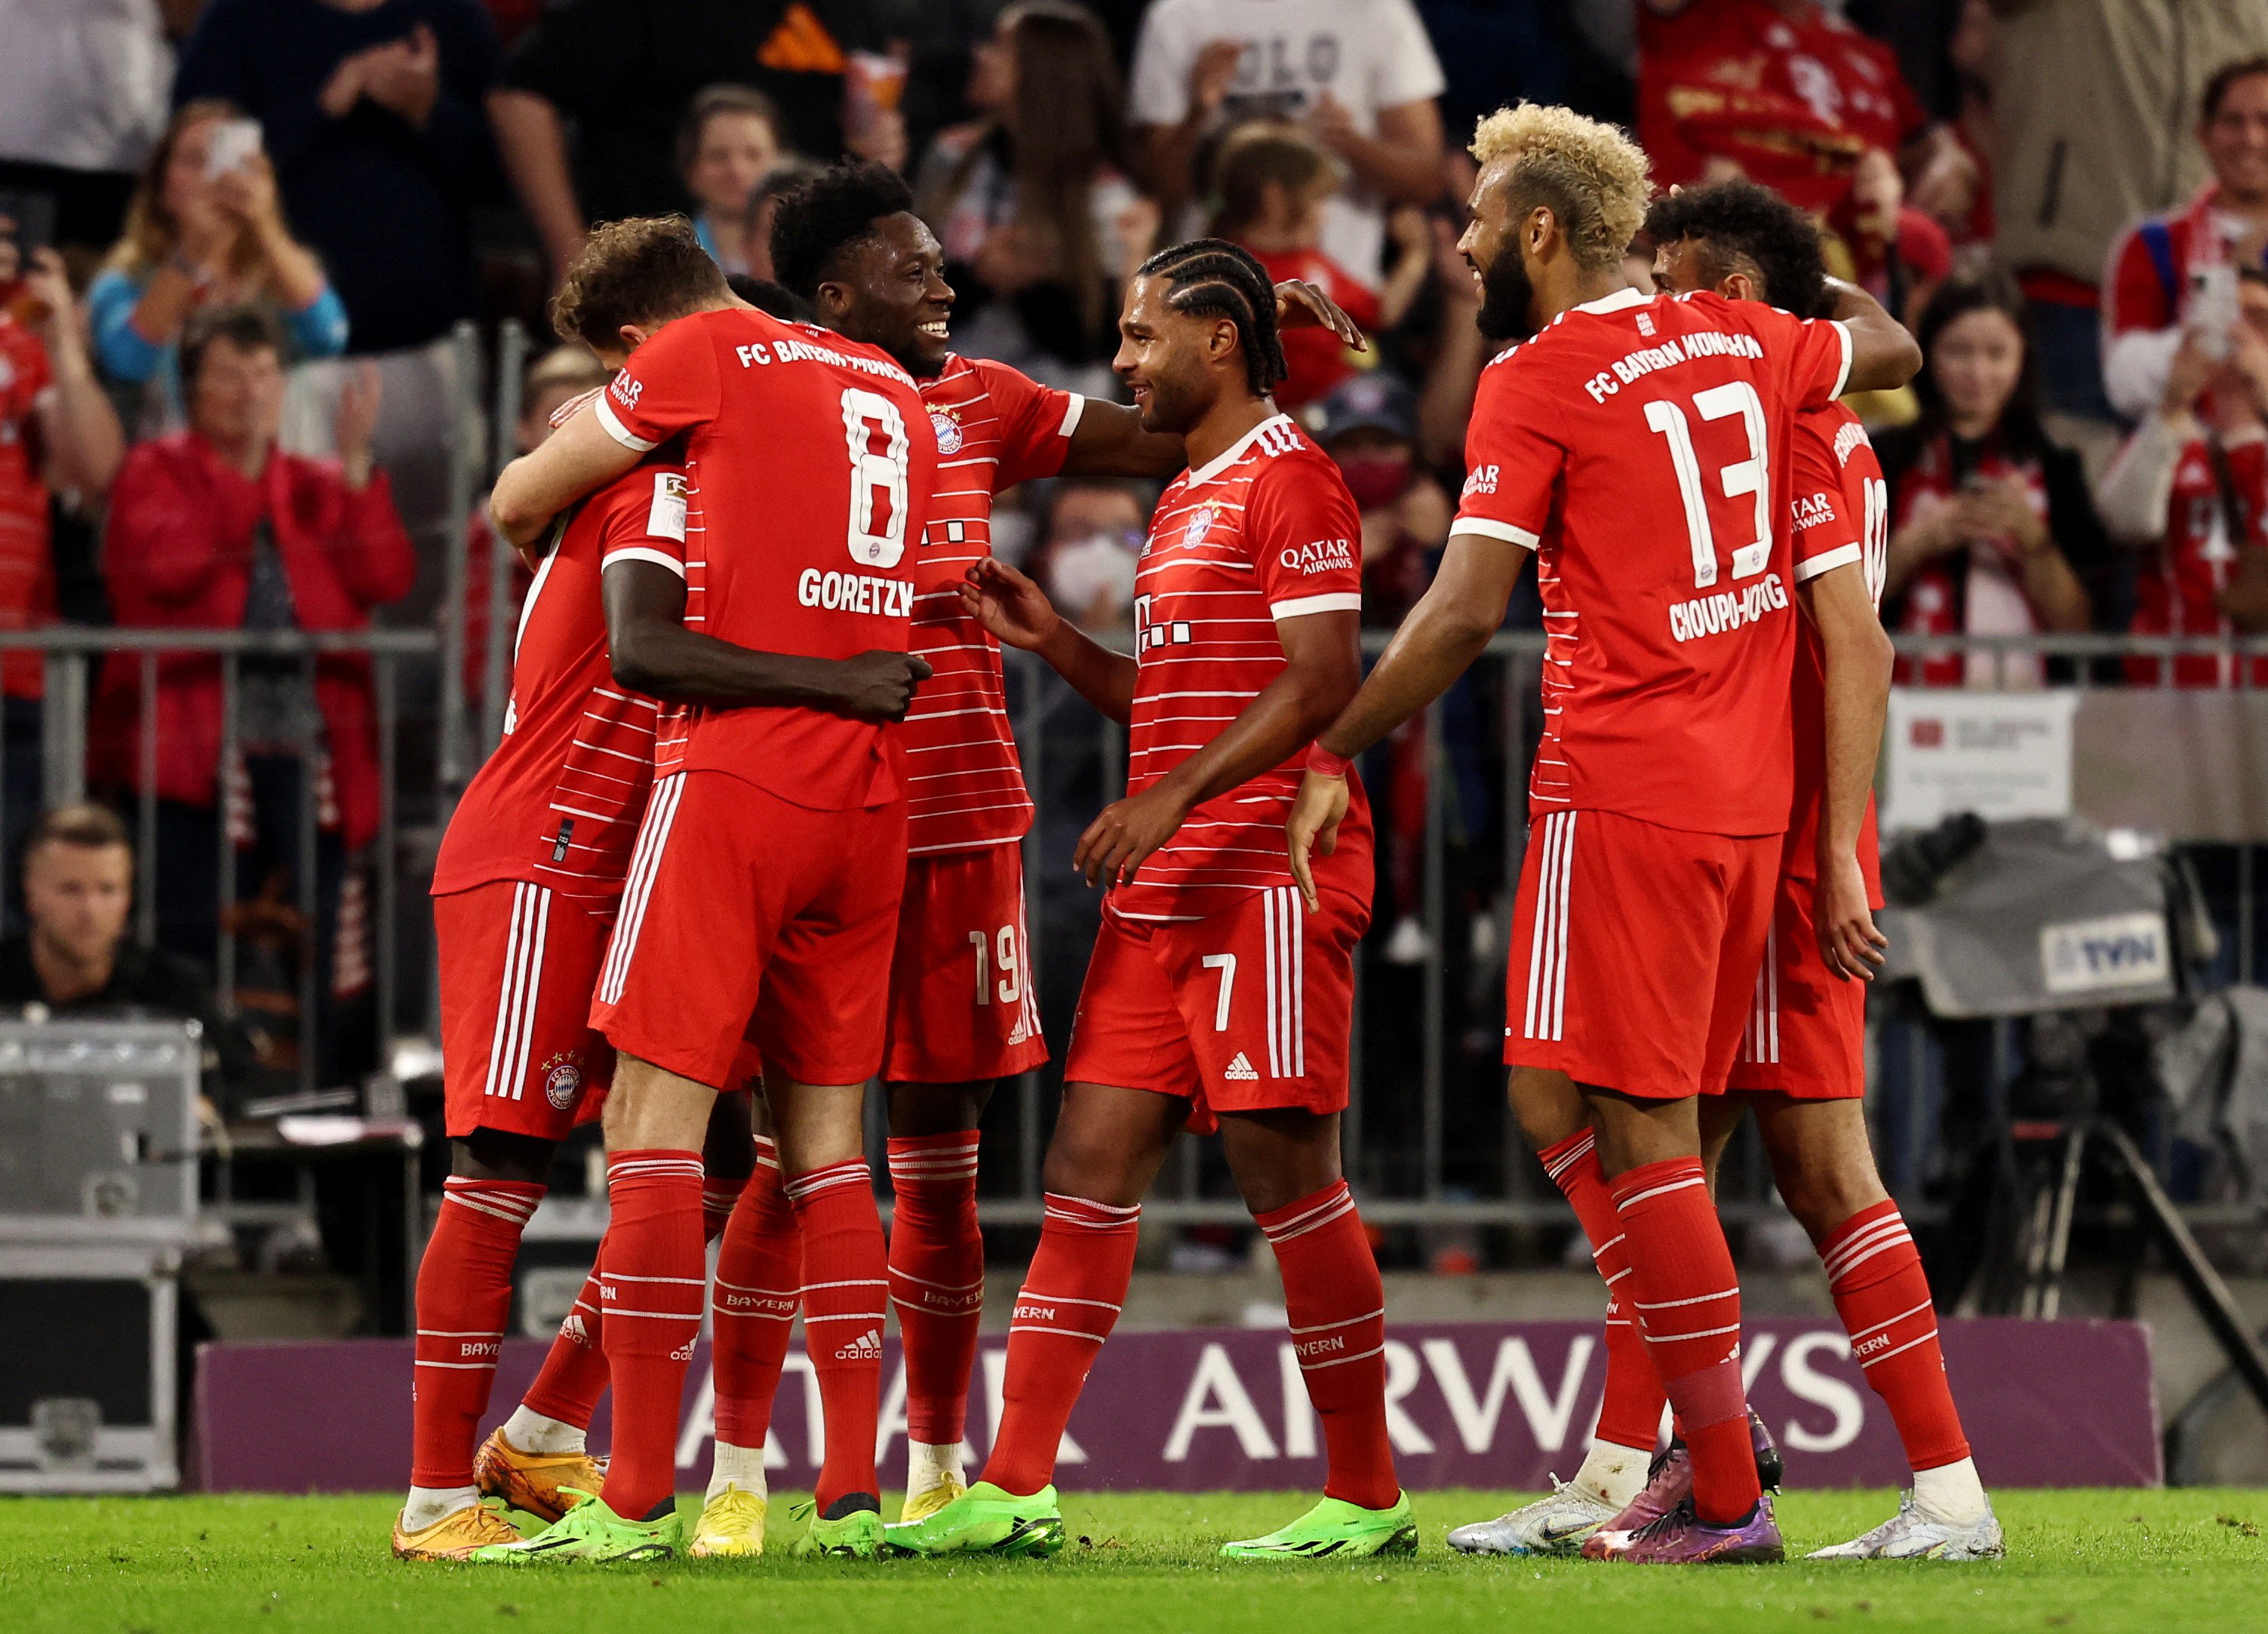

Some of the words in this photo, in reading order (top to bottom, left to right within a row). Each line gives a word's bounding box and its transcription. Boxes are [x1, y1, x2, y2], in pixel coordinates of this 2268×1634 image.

[736, 344, 771, 368] FC
[772, 339, 847, 367] BAYERN
[1584, 372, 1619, 404] FC
[1611, 339, 1686, 385] BAYERN
[841, 387, 910, 569] 8
[1643, 380, 1773, 589] 13
[1280, 539, 1351, 569] QATAR
[1302, 557, 1354, 576] AIRWAYS
[969, 924, 1020, 1005] 19
[1202, 953, 1237, 1032] 7
[1225, 1070, 1259, 1080] adidas
[727, 1294, 794, 1311] BAYERN
[924, 1287, 985, 1307] BAYER
[1013, 1306, 1056, 1321] YERN
[461, 1342, 500, 1356] BAYE
[1293, 1335, 1345, 1356] YERN
[1852, 1333, 1892, 1358] YERN
